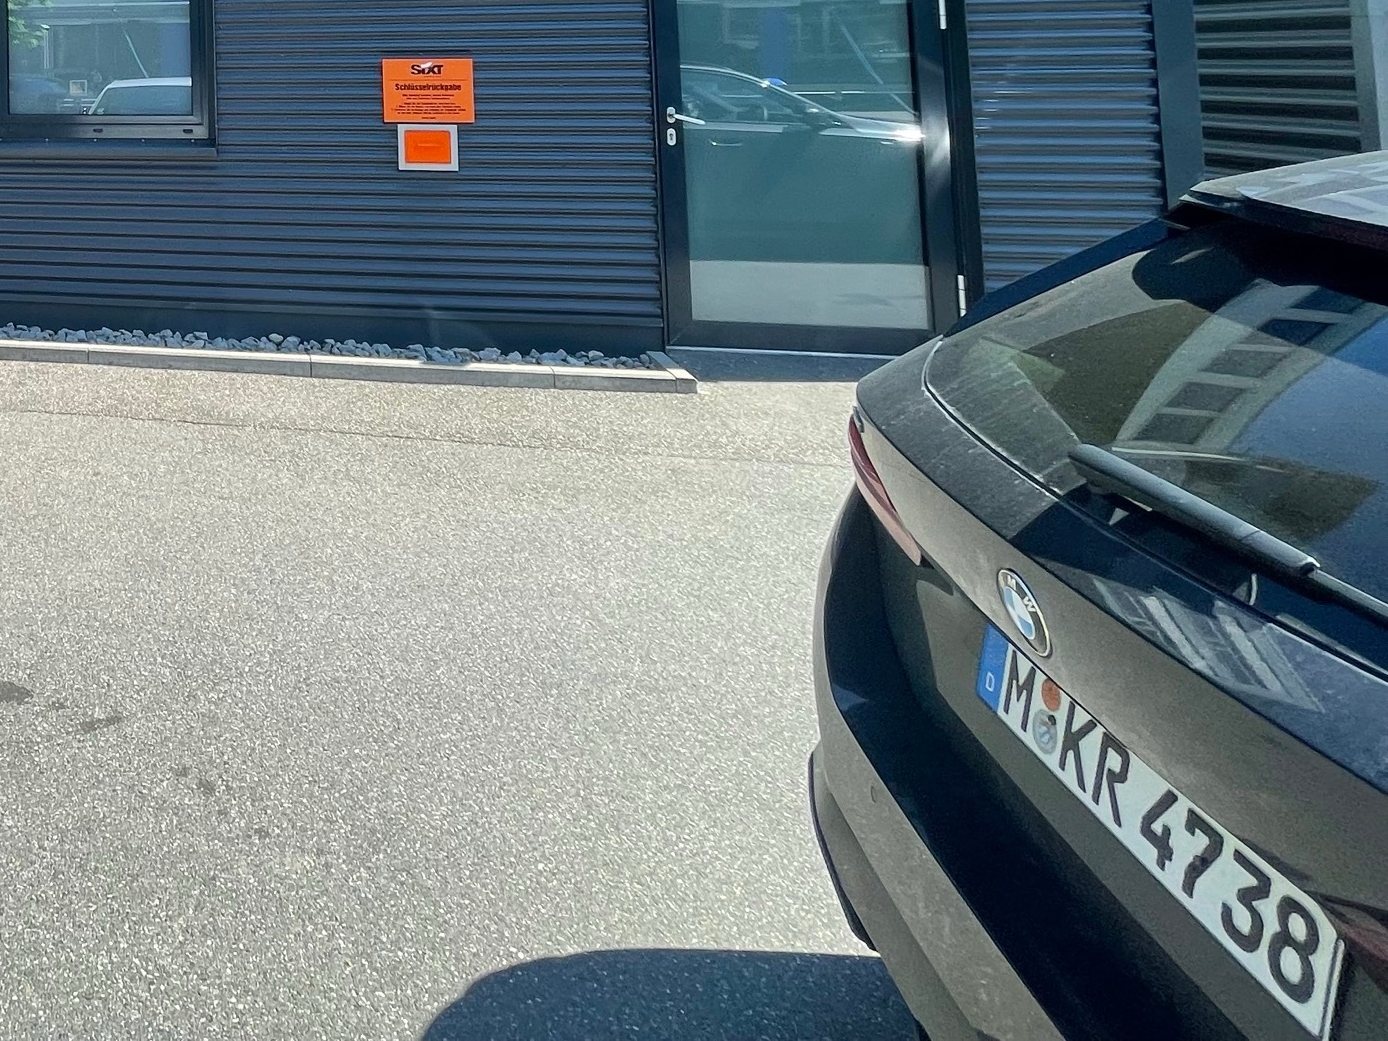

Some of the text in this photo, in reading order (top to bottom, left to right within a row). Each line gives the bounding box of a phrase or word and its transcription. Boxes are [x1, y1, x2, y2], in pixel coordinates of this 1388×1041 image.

[395, 83, 462, 91] Schlüsselrückgabe
[984, 671, 995, 692] D
[1003, 649, 1320, 1005] M KR 4738
